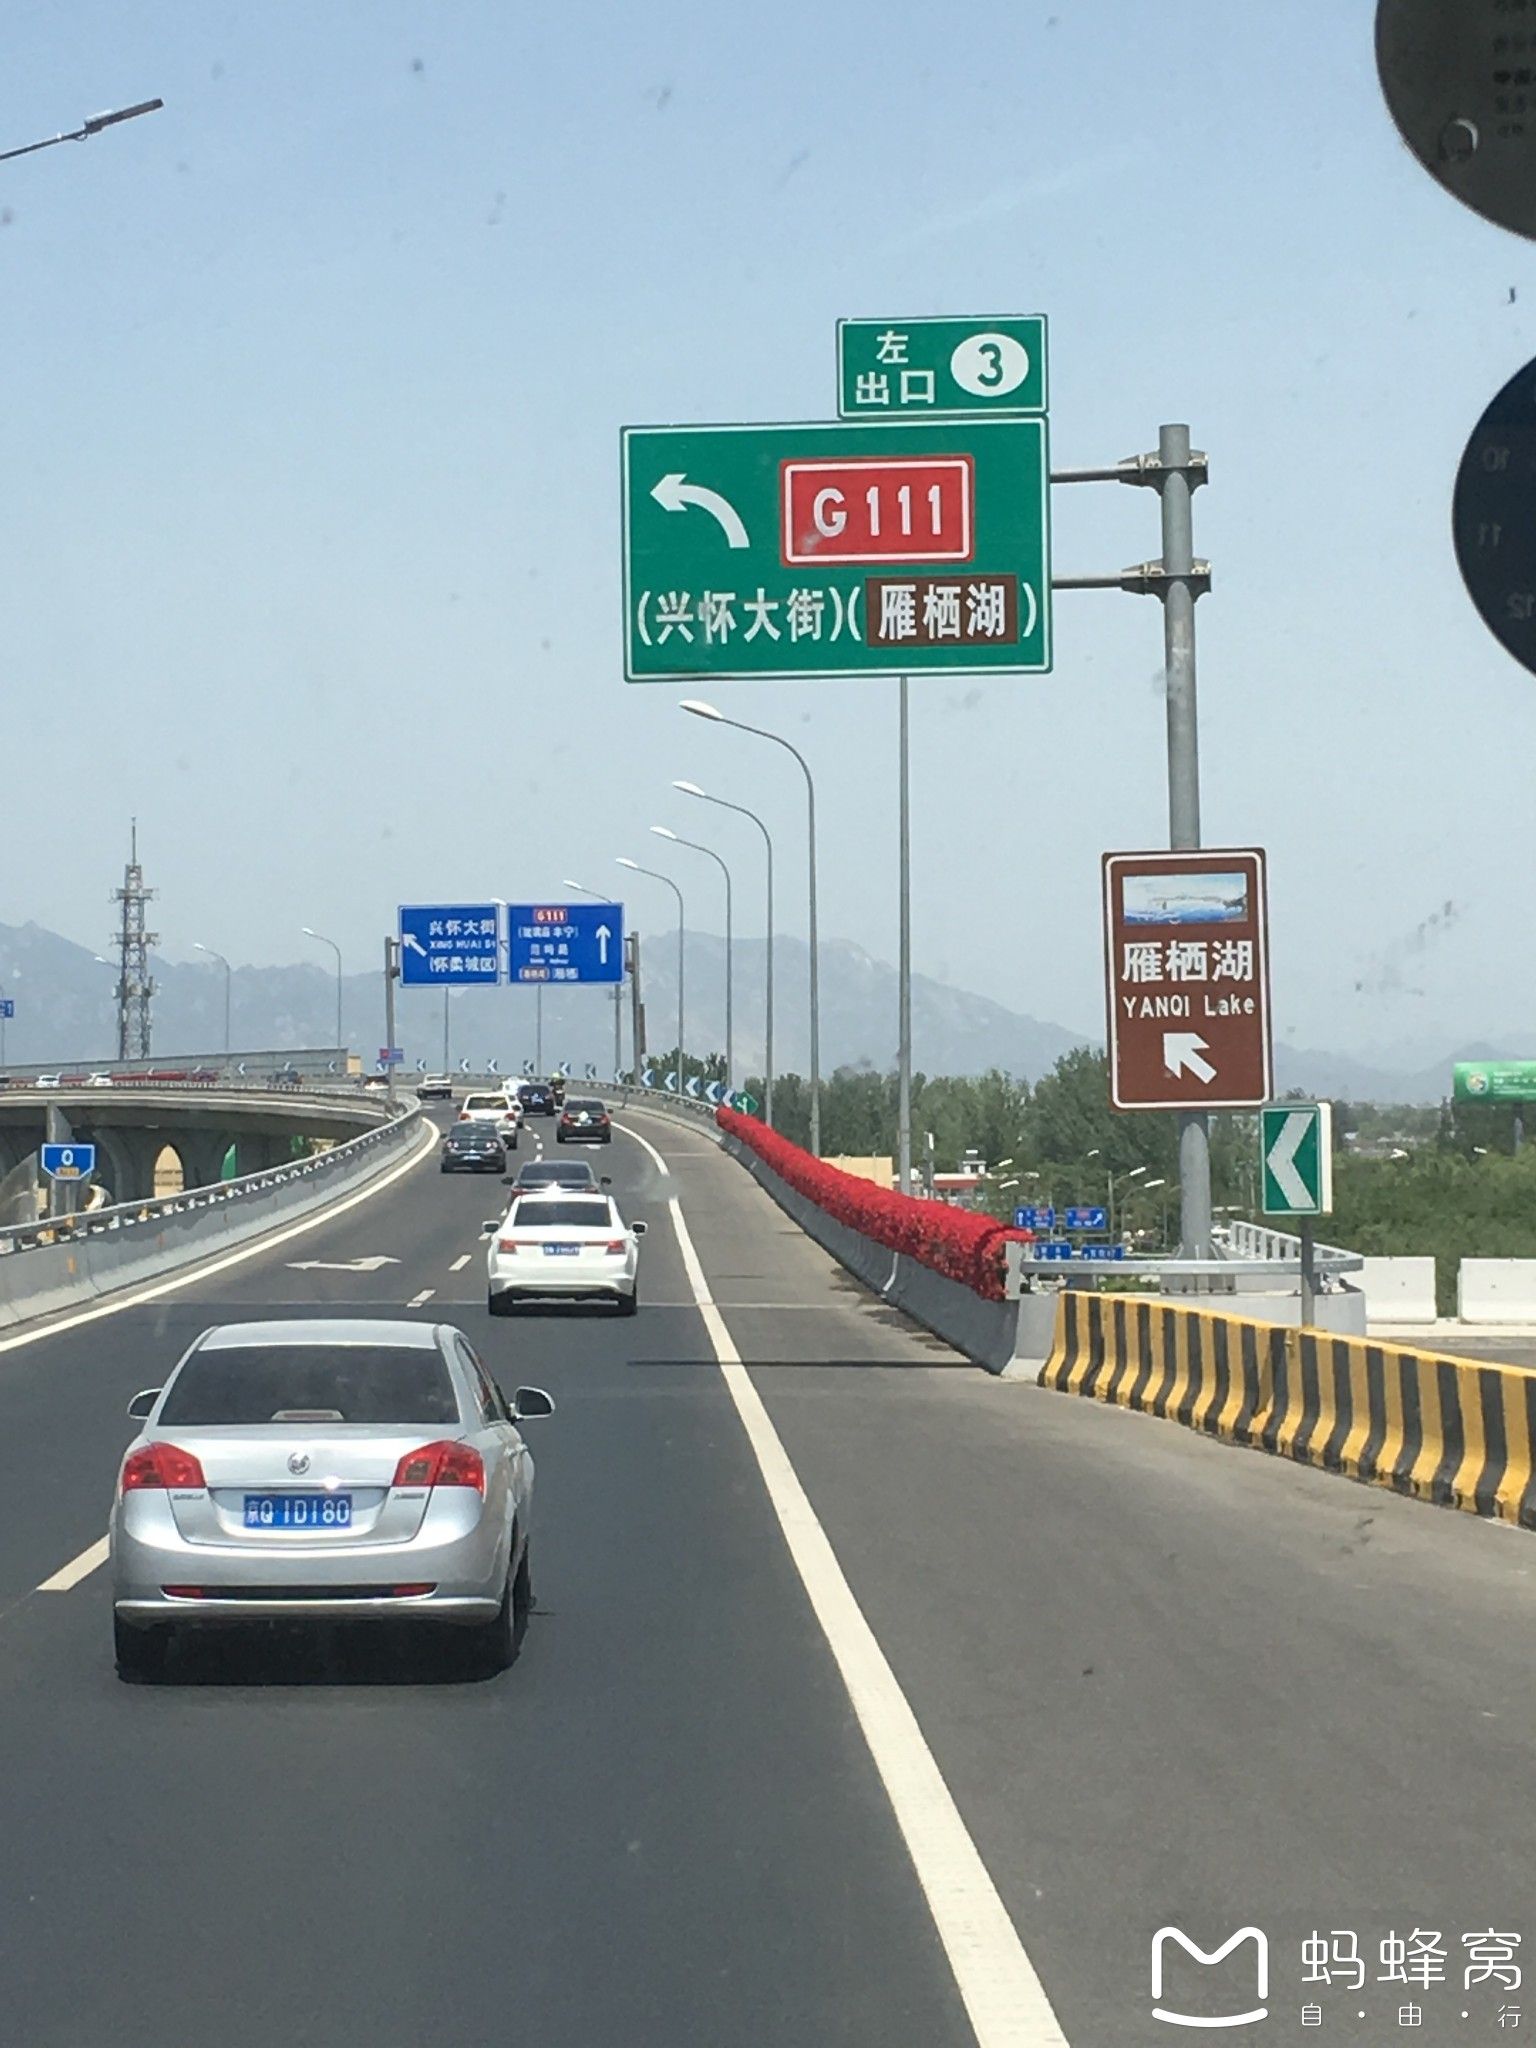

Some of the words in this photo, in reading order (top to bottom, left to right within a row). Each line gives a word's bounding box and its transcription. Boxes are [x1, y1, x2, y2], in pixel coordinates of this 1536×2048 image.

[876, 330, 909, 364] 左
[976, 342, 1004, 387] 3
[855, 369, 936, 405] 出口
[812, 484, 942, 538] G111
[1121, 940, 1253, 983] 雁栖湖
[1122, 995, 1191, 1019] YANQI
[1204, 993, 1255, 1017] Lake
